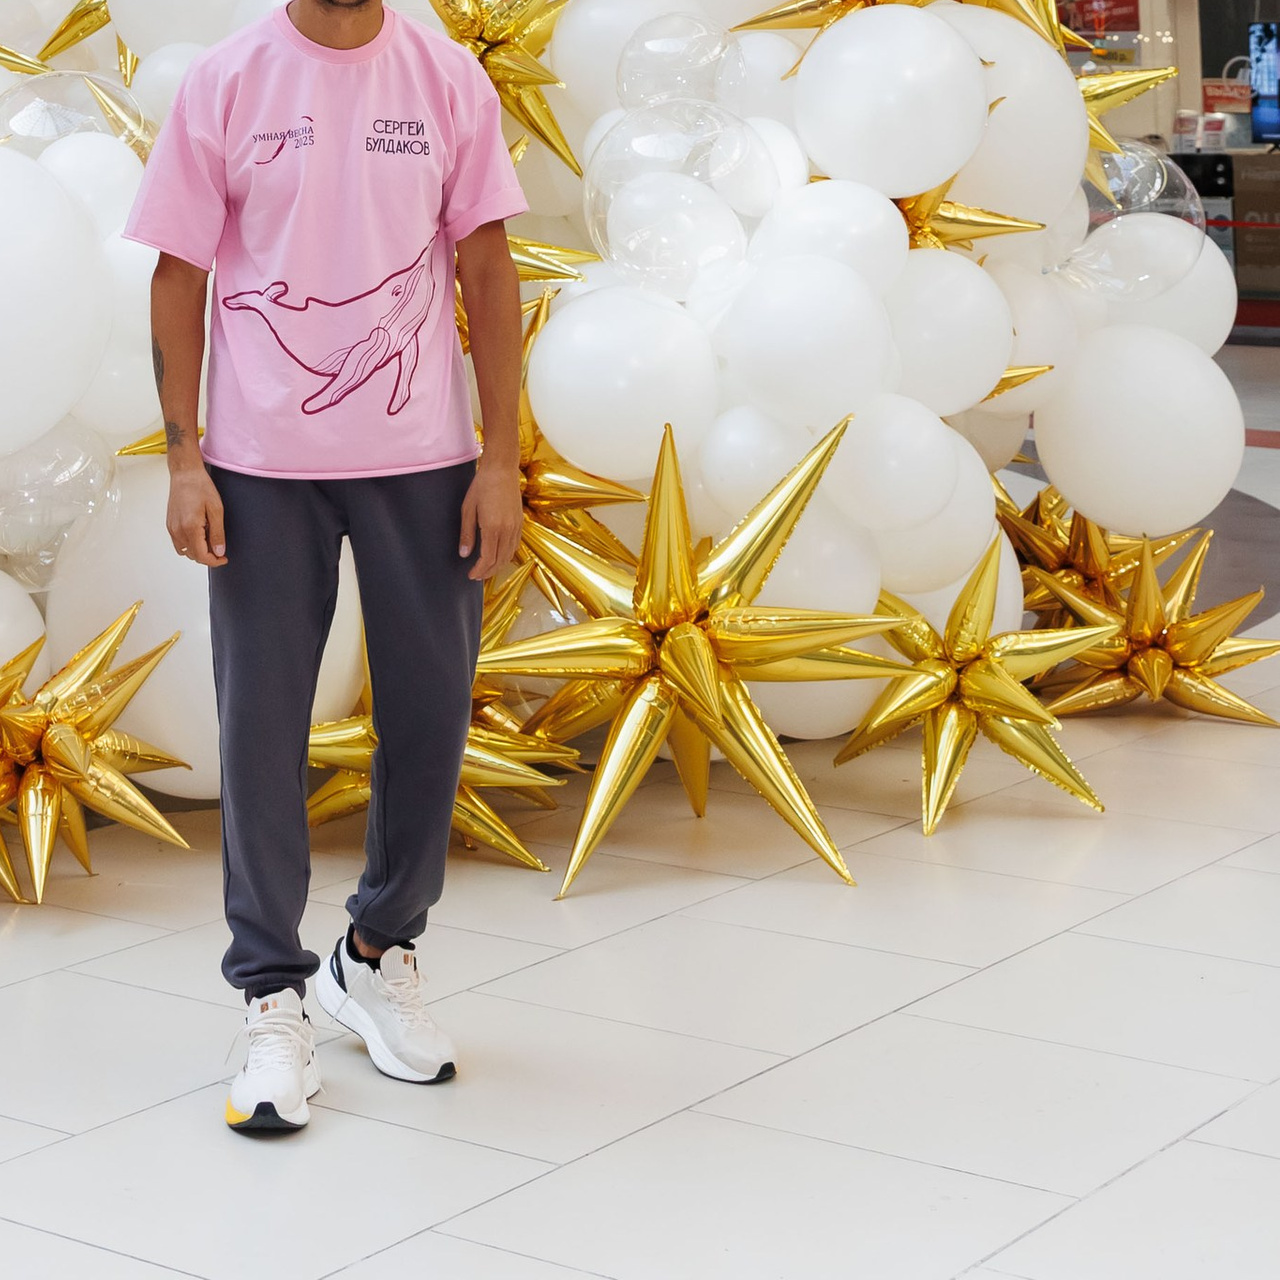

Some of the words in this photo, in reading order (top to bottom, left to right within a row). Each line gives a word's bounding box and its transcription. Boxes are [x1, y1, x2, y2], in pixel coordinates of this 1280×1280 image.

[252, 131, 287, 144] УМНАЯ
[287, 125, 314, 140] ВЕСНА
[372, 119, 425, 137] СЕРГЕЙ
[294, 135, 315, 149] 2025
[366, 137, 431, 156] БУЛДАКОВ
